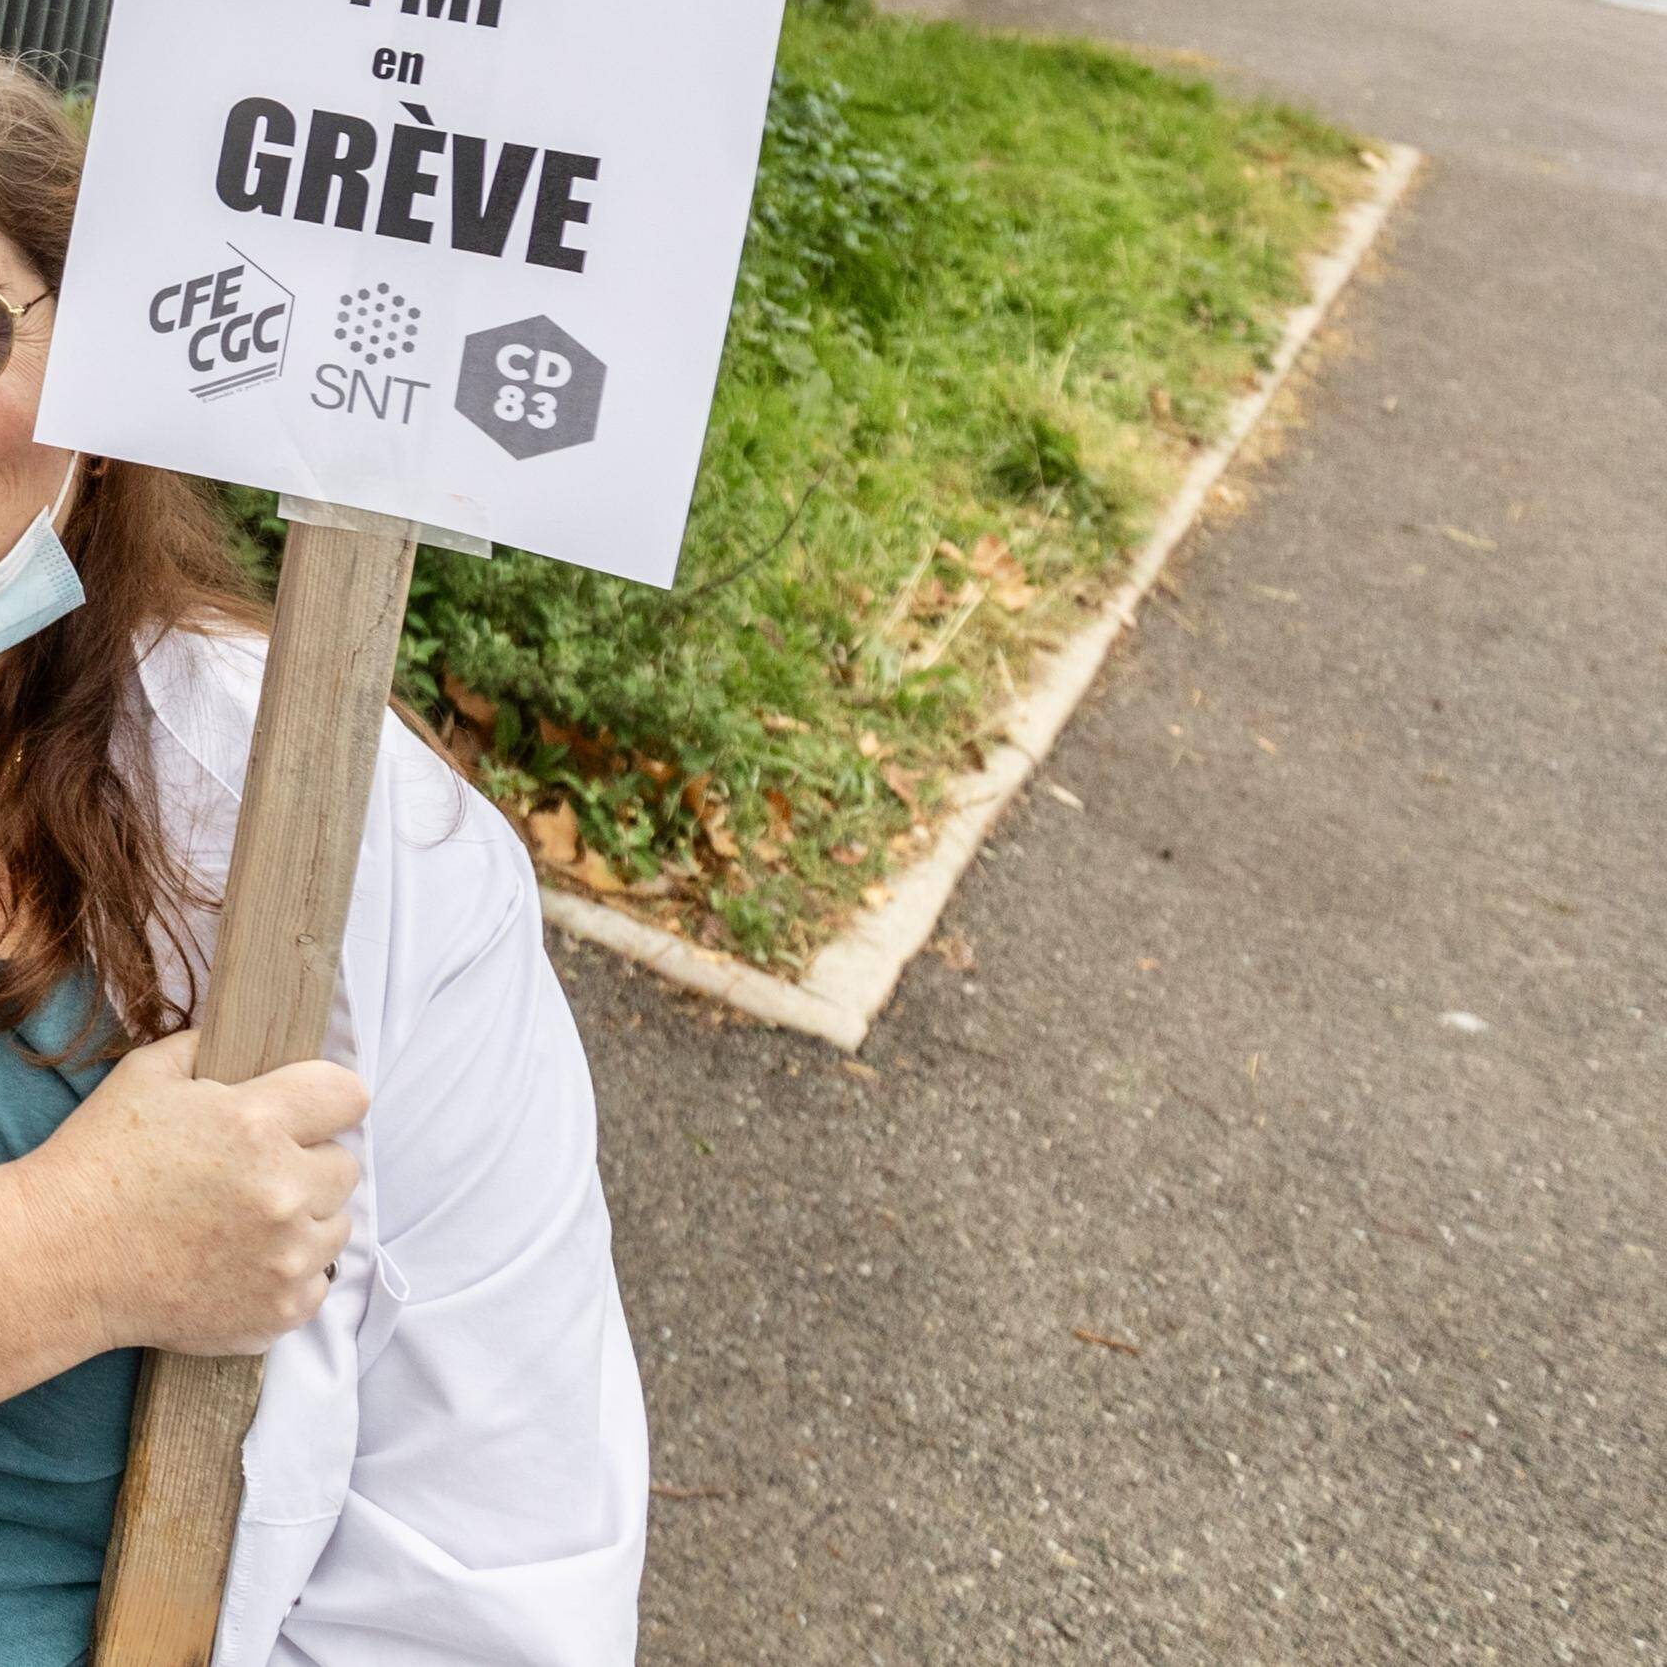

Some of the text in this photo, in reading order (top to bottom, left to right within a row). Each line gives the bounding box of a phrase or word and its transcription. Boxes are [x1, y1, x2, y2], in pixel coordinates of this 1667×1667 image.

[371, 44, 424, 86] en
[215, 96, 601, 275] GRÈVE
[149, 264, 245, 334] CFE
[188, 303, 286, 373] CGC
[494, 340, 573, 389] CD
[309, 363, 431, 426] SNT
[493, 387, 558, 431] 83
